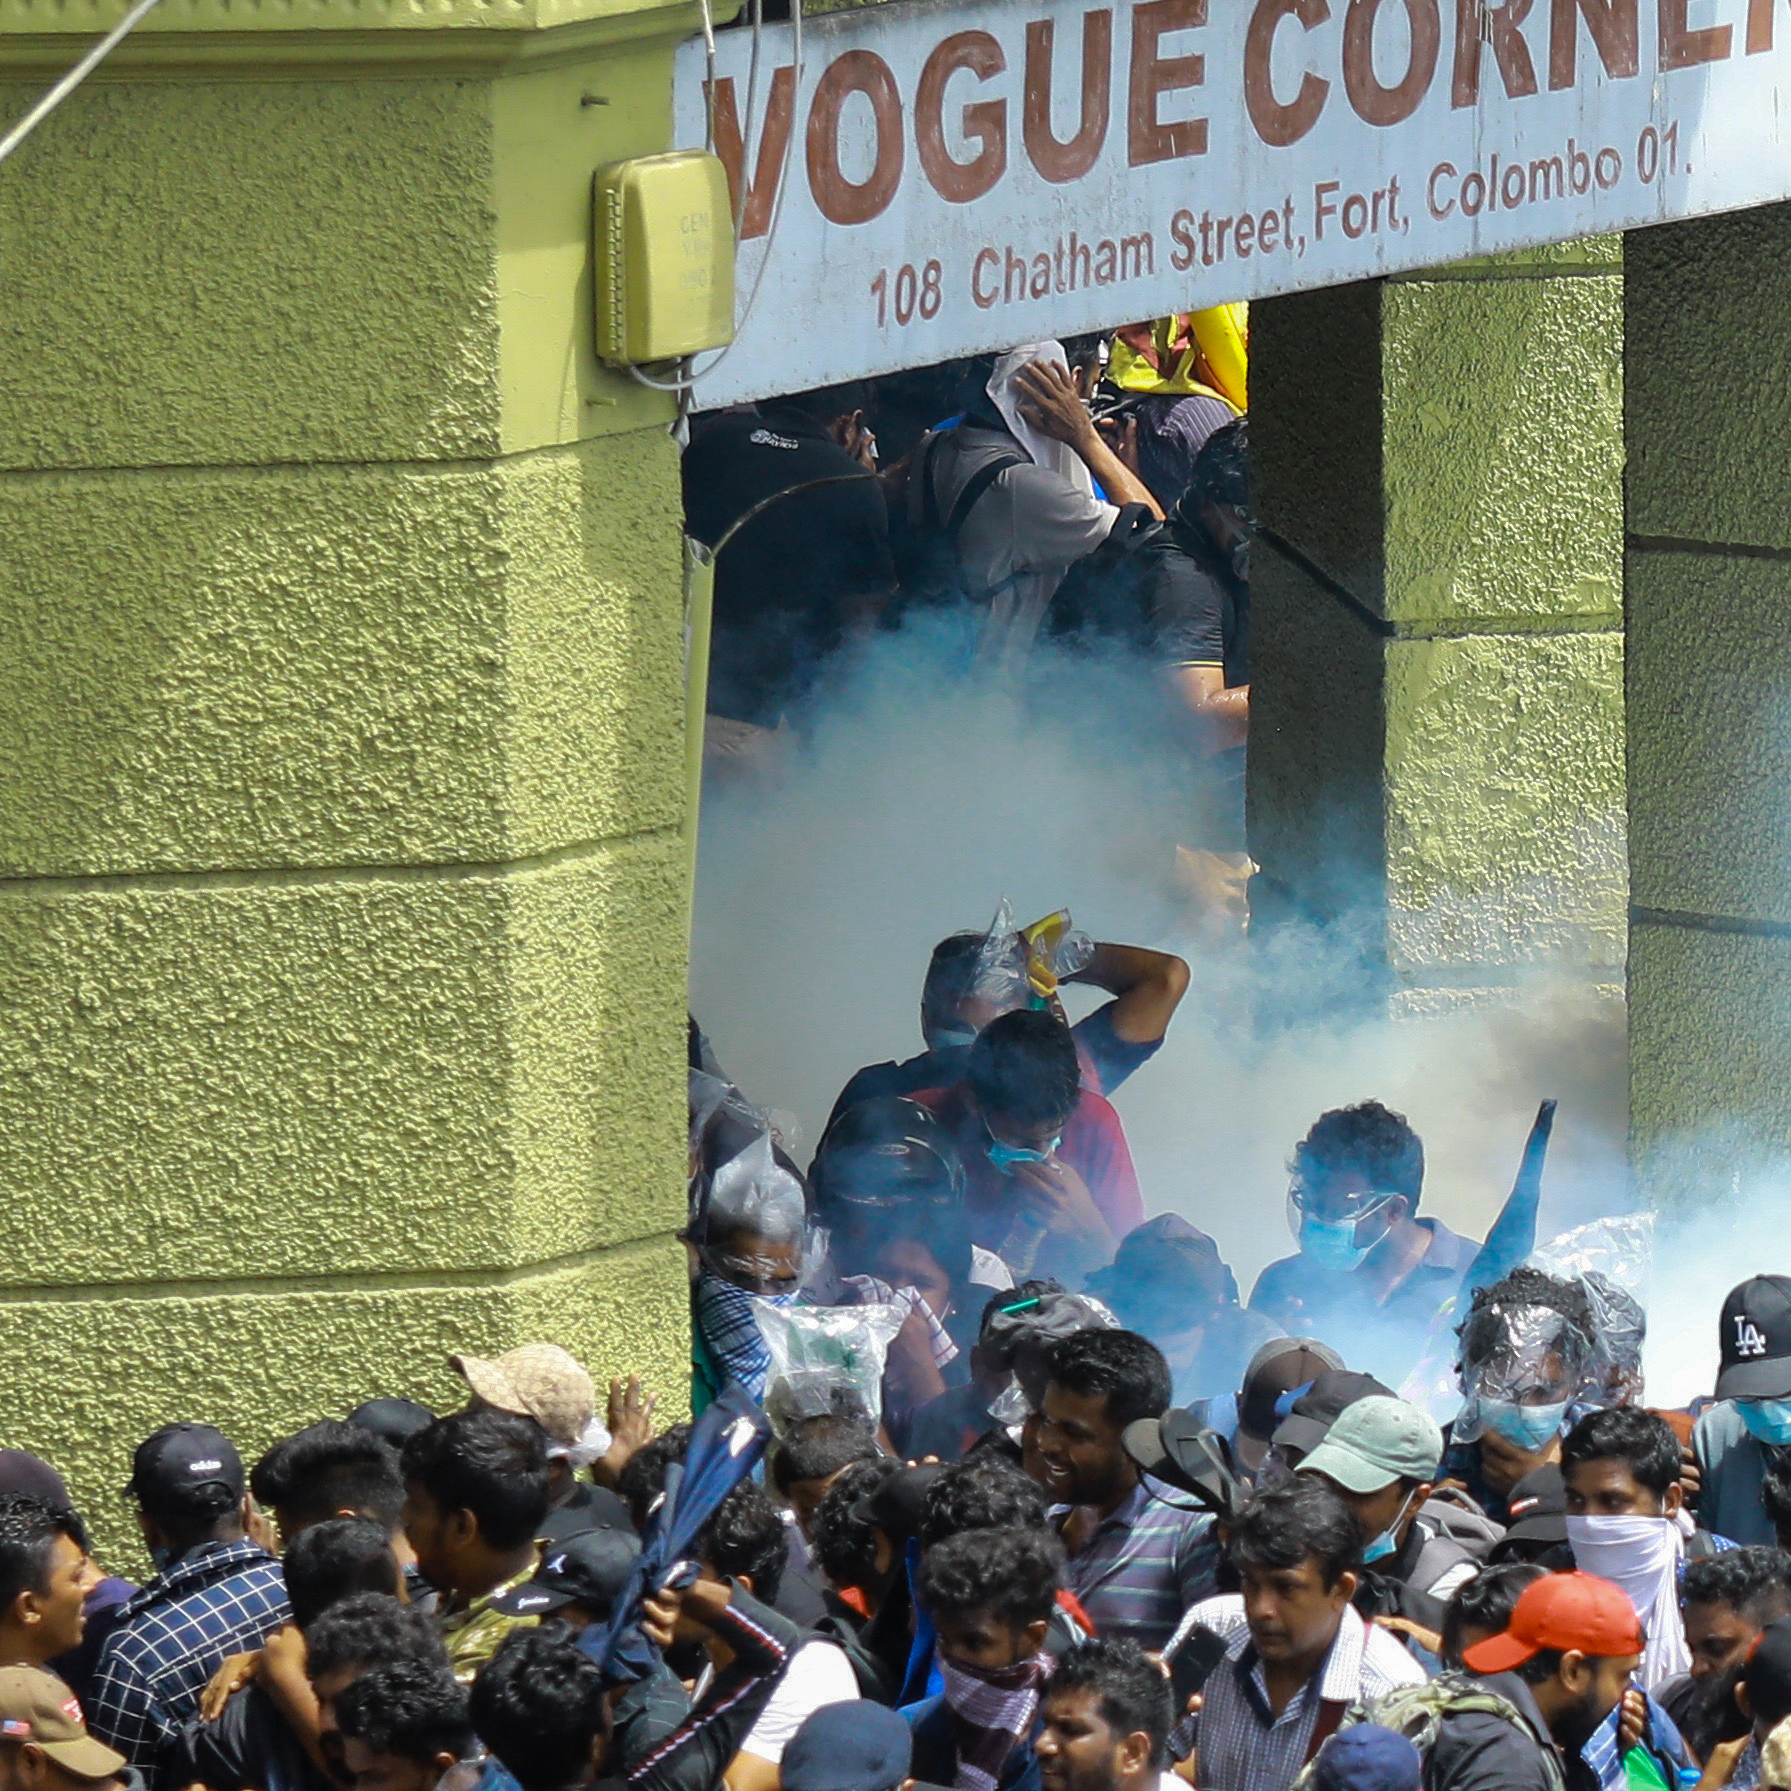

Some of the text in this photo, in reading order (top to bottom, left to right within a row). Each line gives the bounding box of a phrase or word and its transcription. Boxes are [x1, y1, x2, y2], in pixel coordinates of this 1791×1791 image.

[703, 0, 1208, 240] VOGUE
[870, 121, 1693, 328] 108 Chatham Street, Fort, Colombo 01.
[1734, 1315, 1767, 1357] LA
